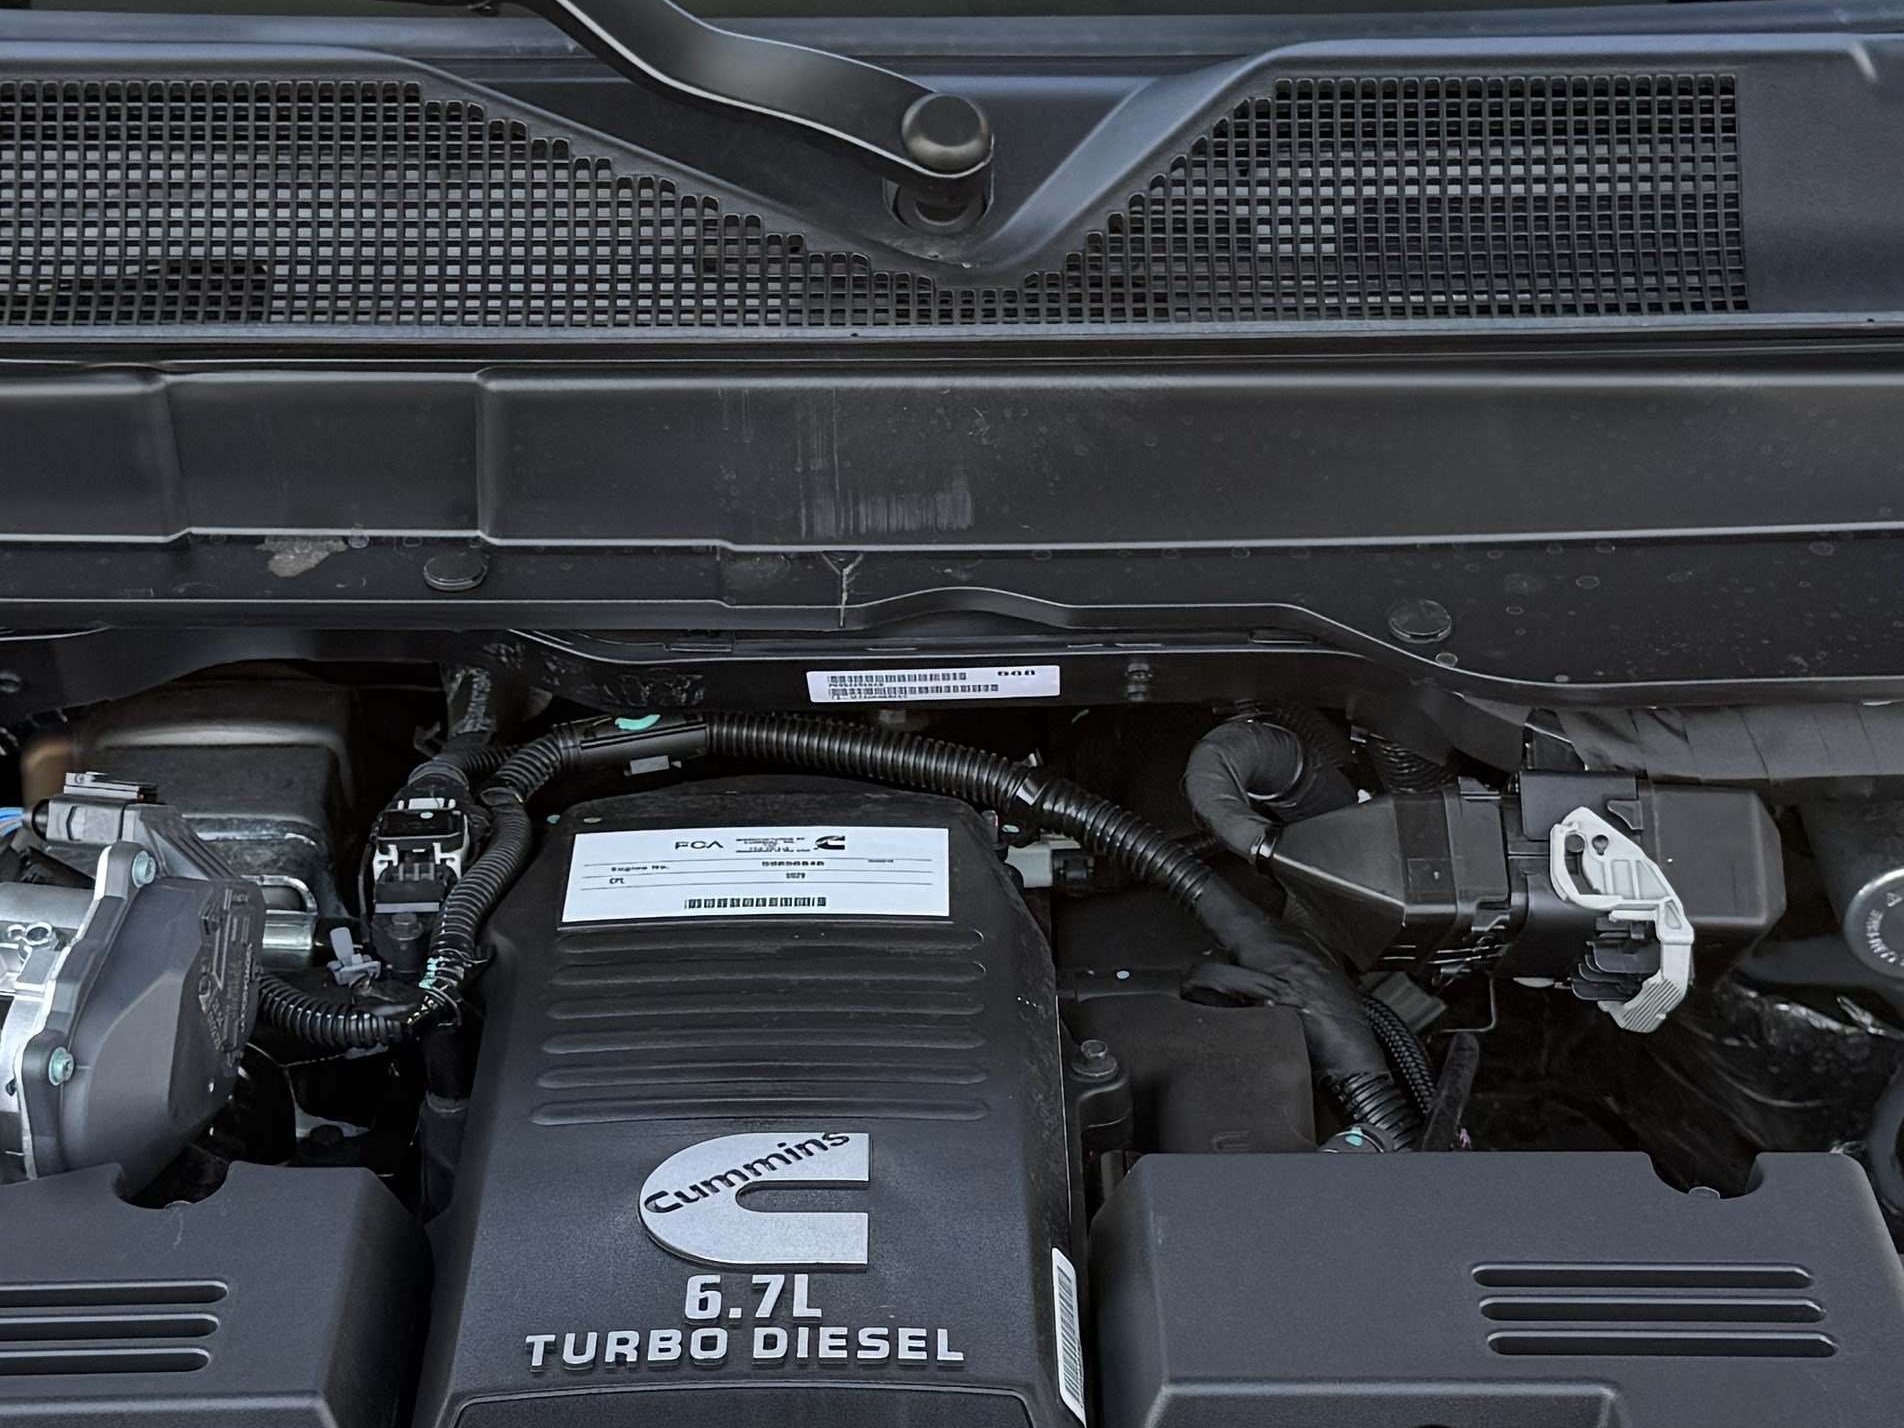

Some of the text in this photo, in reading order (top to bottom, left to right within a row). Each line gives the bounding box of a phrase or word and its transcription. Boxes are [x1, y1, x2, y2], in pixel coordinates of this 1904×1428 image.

[644, 1128, 851, 1215] Cummins
[684, 1273, 823, 1323] 6.7L
[525, 1326, 965, 1370] TURBO DIESEL
